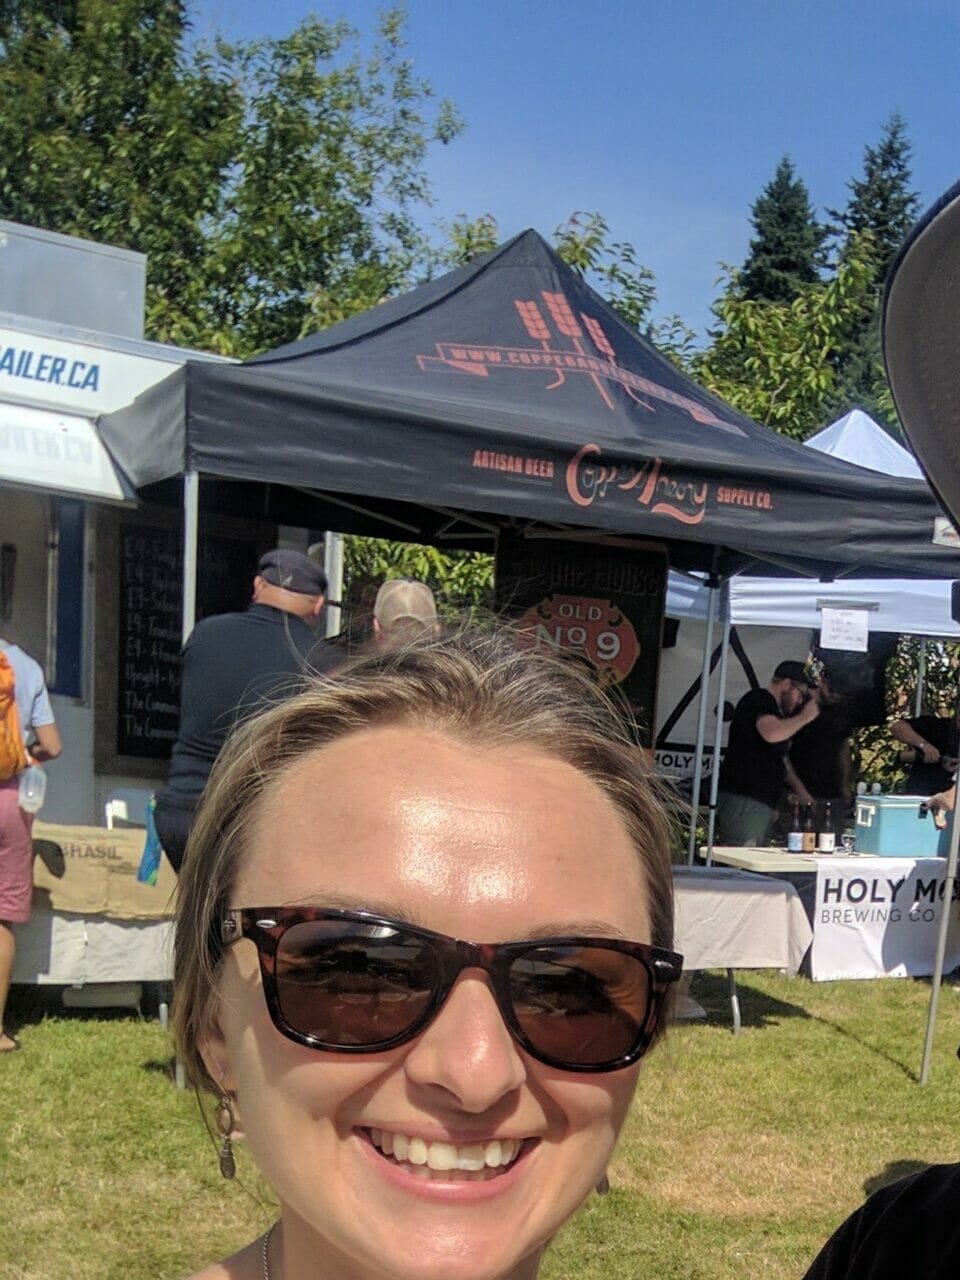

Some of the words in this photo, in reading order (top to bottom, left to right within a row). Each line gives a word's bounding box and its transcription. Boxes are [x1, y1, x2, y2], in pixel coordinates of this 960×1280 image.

[525, 458, 554, 477] BEER
[566, 443, 636, 506] Copp
[717, 486, 755, 506] SUPPLY
[559, 603, 602, 621] OLD
[823, 877, 906, 903] HOLY
[821, 908, 902, 923] BREWING
